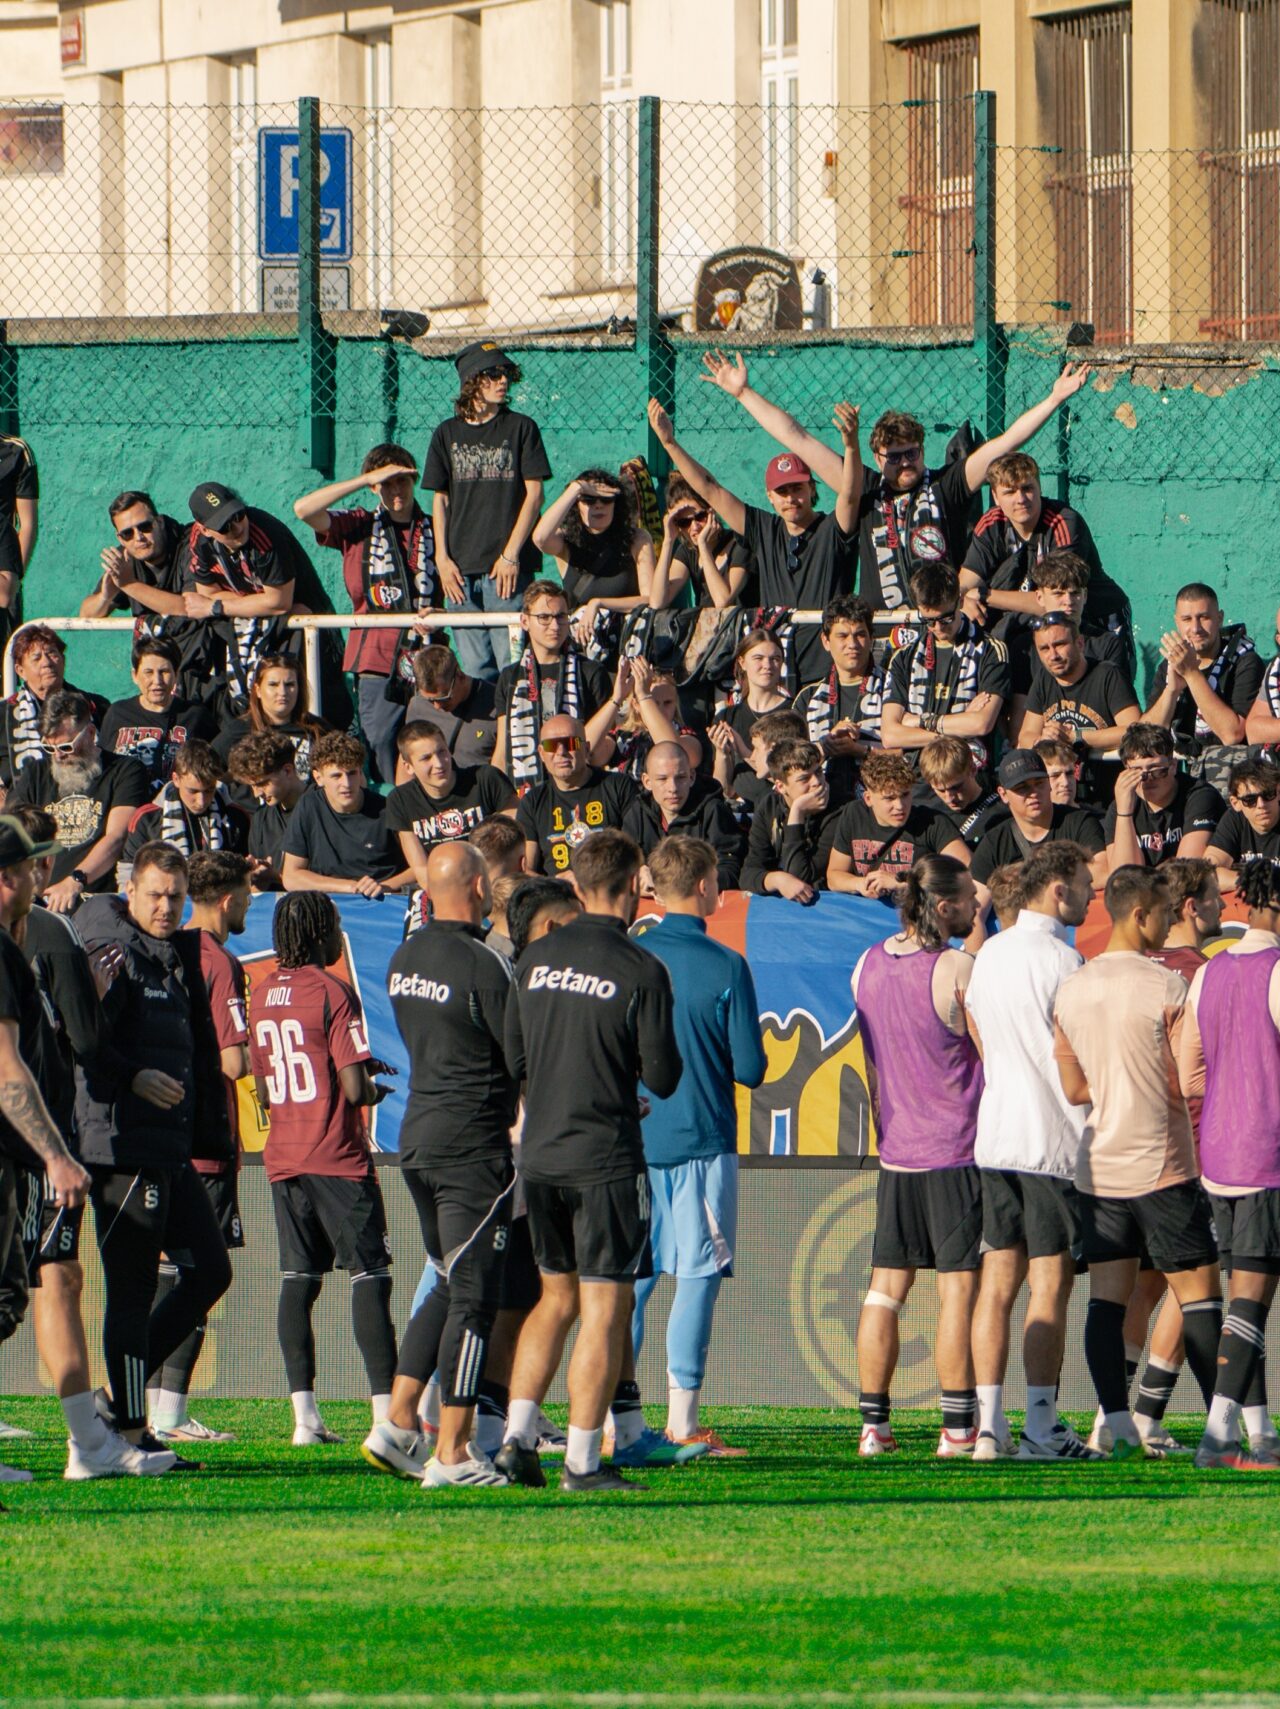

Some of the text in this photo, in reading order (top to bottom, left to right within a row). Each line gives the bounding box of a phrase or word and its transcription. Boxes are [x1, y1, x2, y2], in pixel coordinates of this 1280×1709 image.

[280, 145, 331, 218] P
[586, 801, 604, 825] 8
[552, 843, 569, 869] 9
[144, 987, 168, 999] Sparta
[389, 972, 450, 1003] Betano
[528, 965, 616, 999] Betano
[256, 1019, 317, 1104] 36
